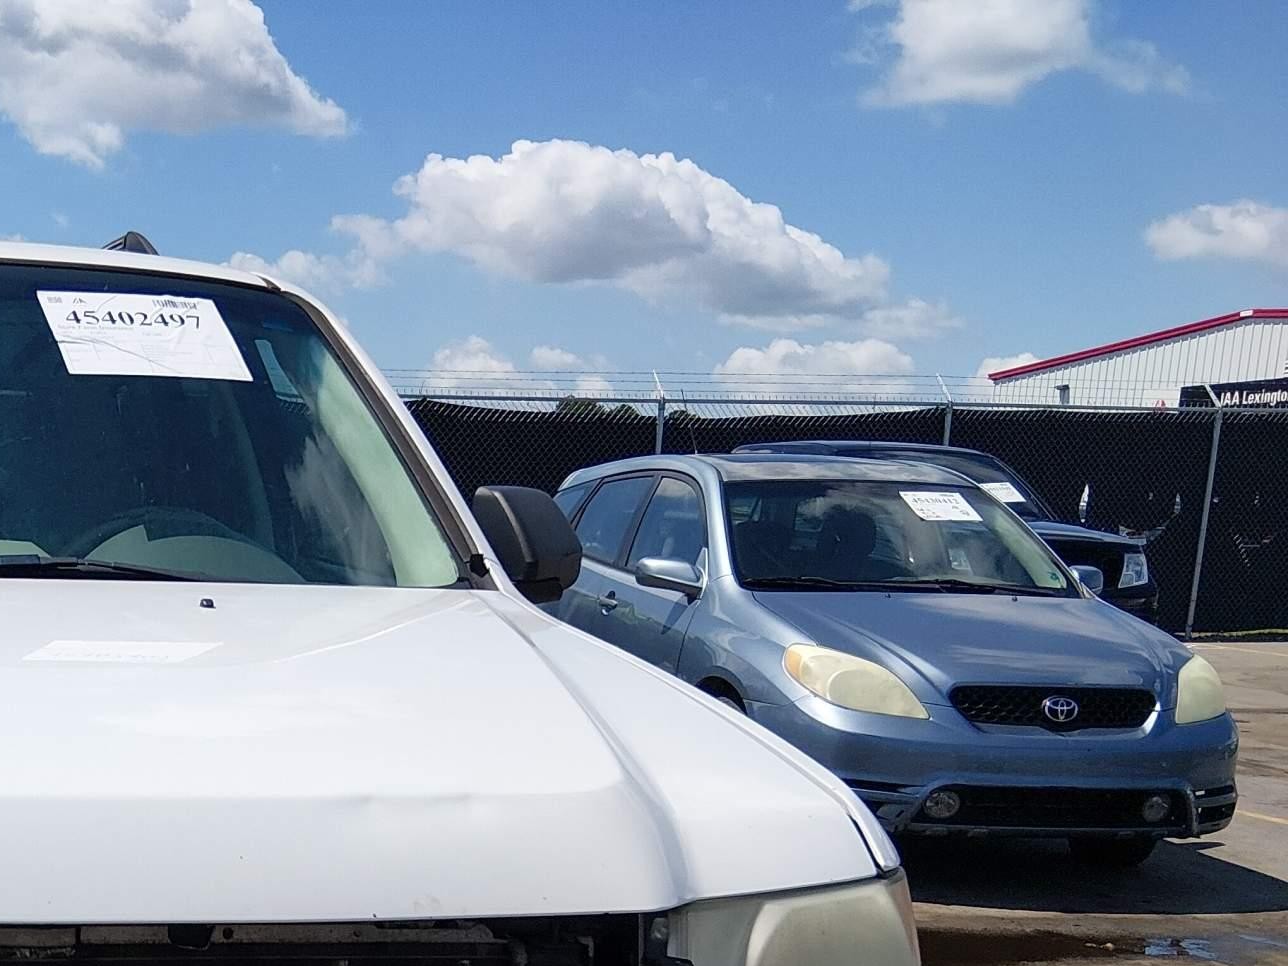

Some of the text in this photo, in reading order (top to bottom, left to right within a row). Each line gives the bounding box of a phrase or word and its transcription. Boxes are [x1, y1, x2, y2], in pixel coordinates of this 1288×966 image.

[66, 310, 200, 329] 45402497
[1220, 389, 1288, 406] IAA Lexingto
